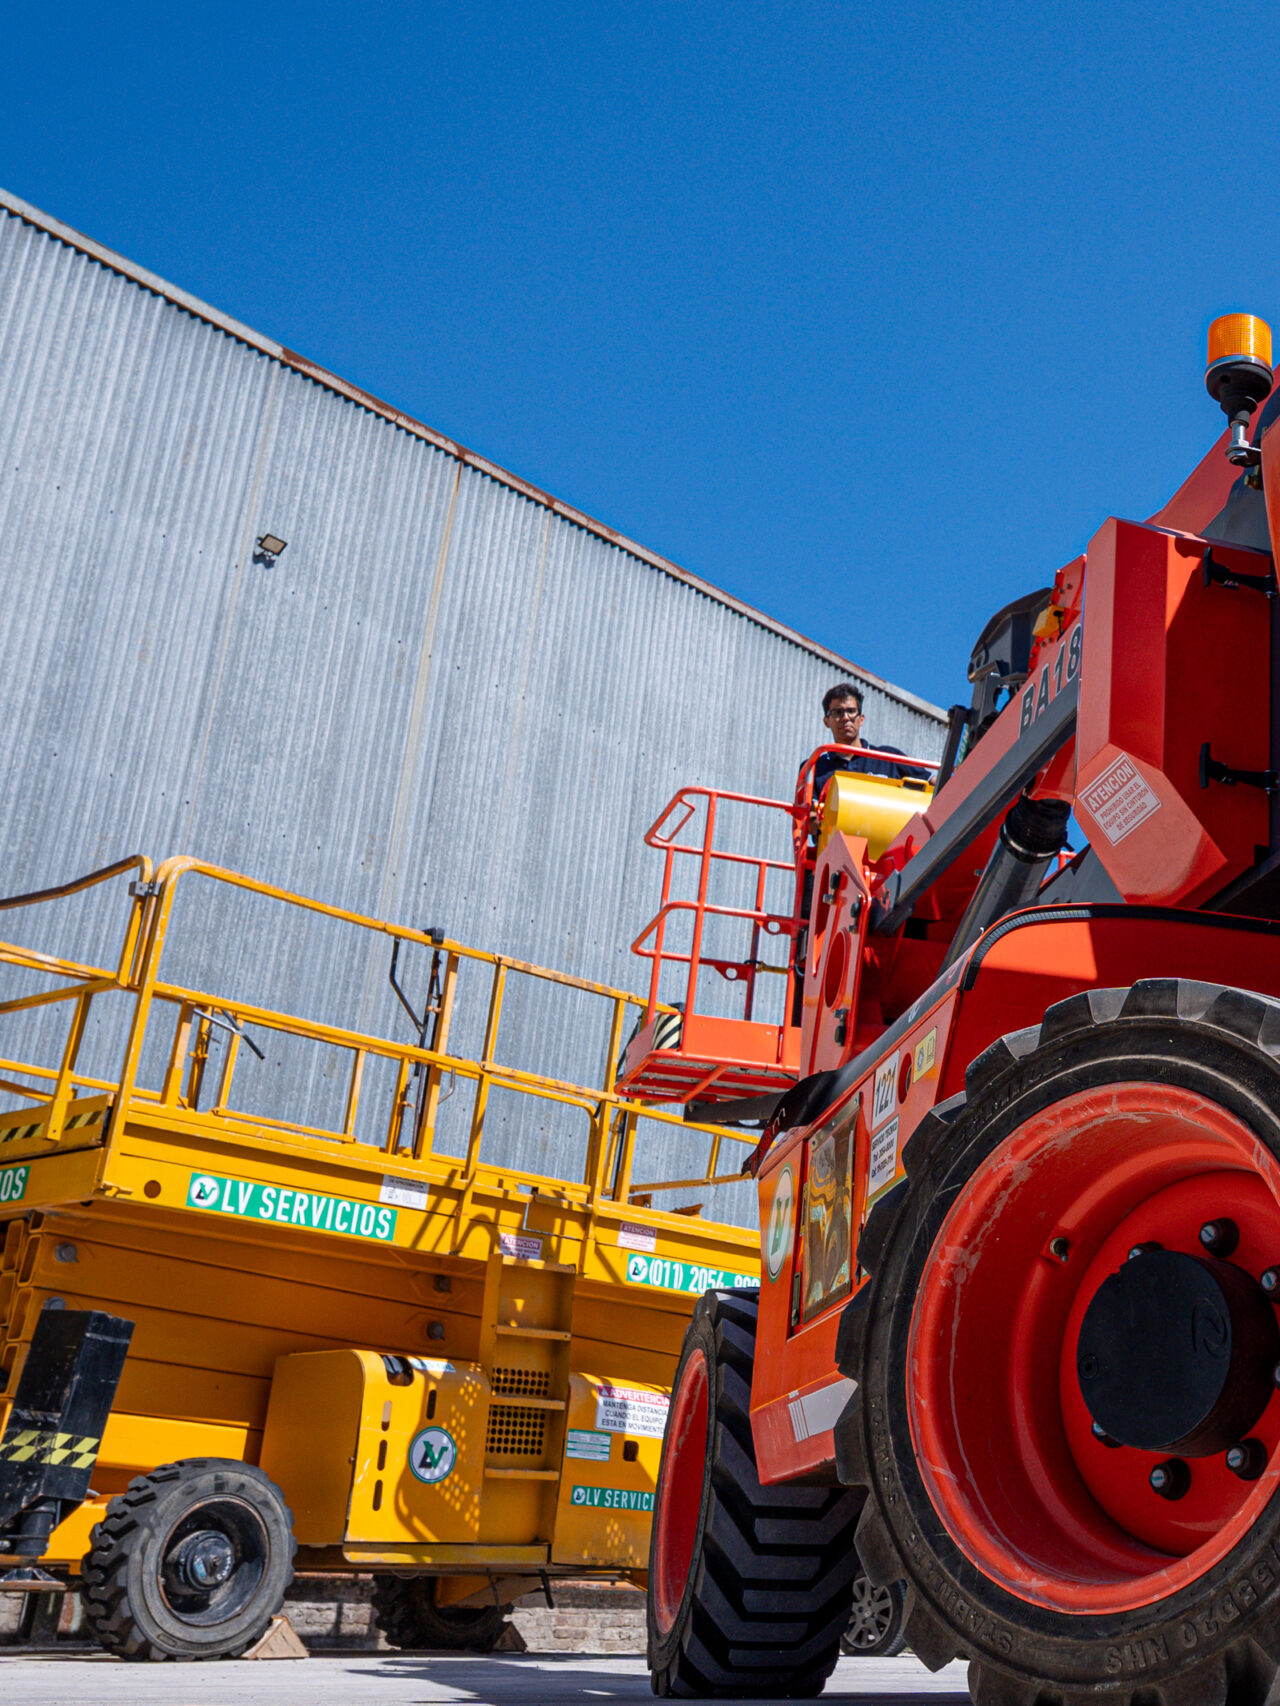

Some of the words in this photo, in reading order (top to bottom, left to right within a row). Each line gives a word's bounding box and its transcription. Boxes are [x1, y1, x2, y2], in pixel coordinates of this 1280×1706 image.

[1018, 622, 1082, 739] BA18
[1087, 762, 1134, 811] ATENCION
[875, 1062, 897, 1117] 1221
[221, 1179, 254, 1213] LV
[259, 1187, 394, 1240] SERVICIOS
[648, 1258, 684, 1290] (011)
[603, 1400, 636, 1411] MANTENGA
[637, 1405, 668, 1416] DISTANCIA
[610, 1389, 670, 1406] ADVERTENCIA
[605, 1409, 632, 1420] CUANDO
[641, 1415, 663, 1425] EQUIPO
[586, 1488, 601, 1506] LV
[1104, 1633, 1170, 1674] NHS
